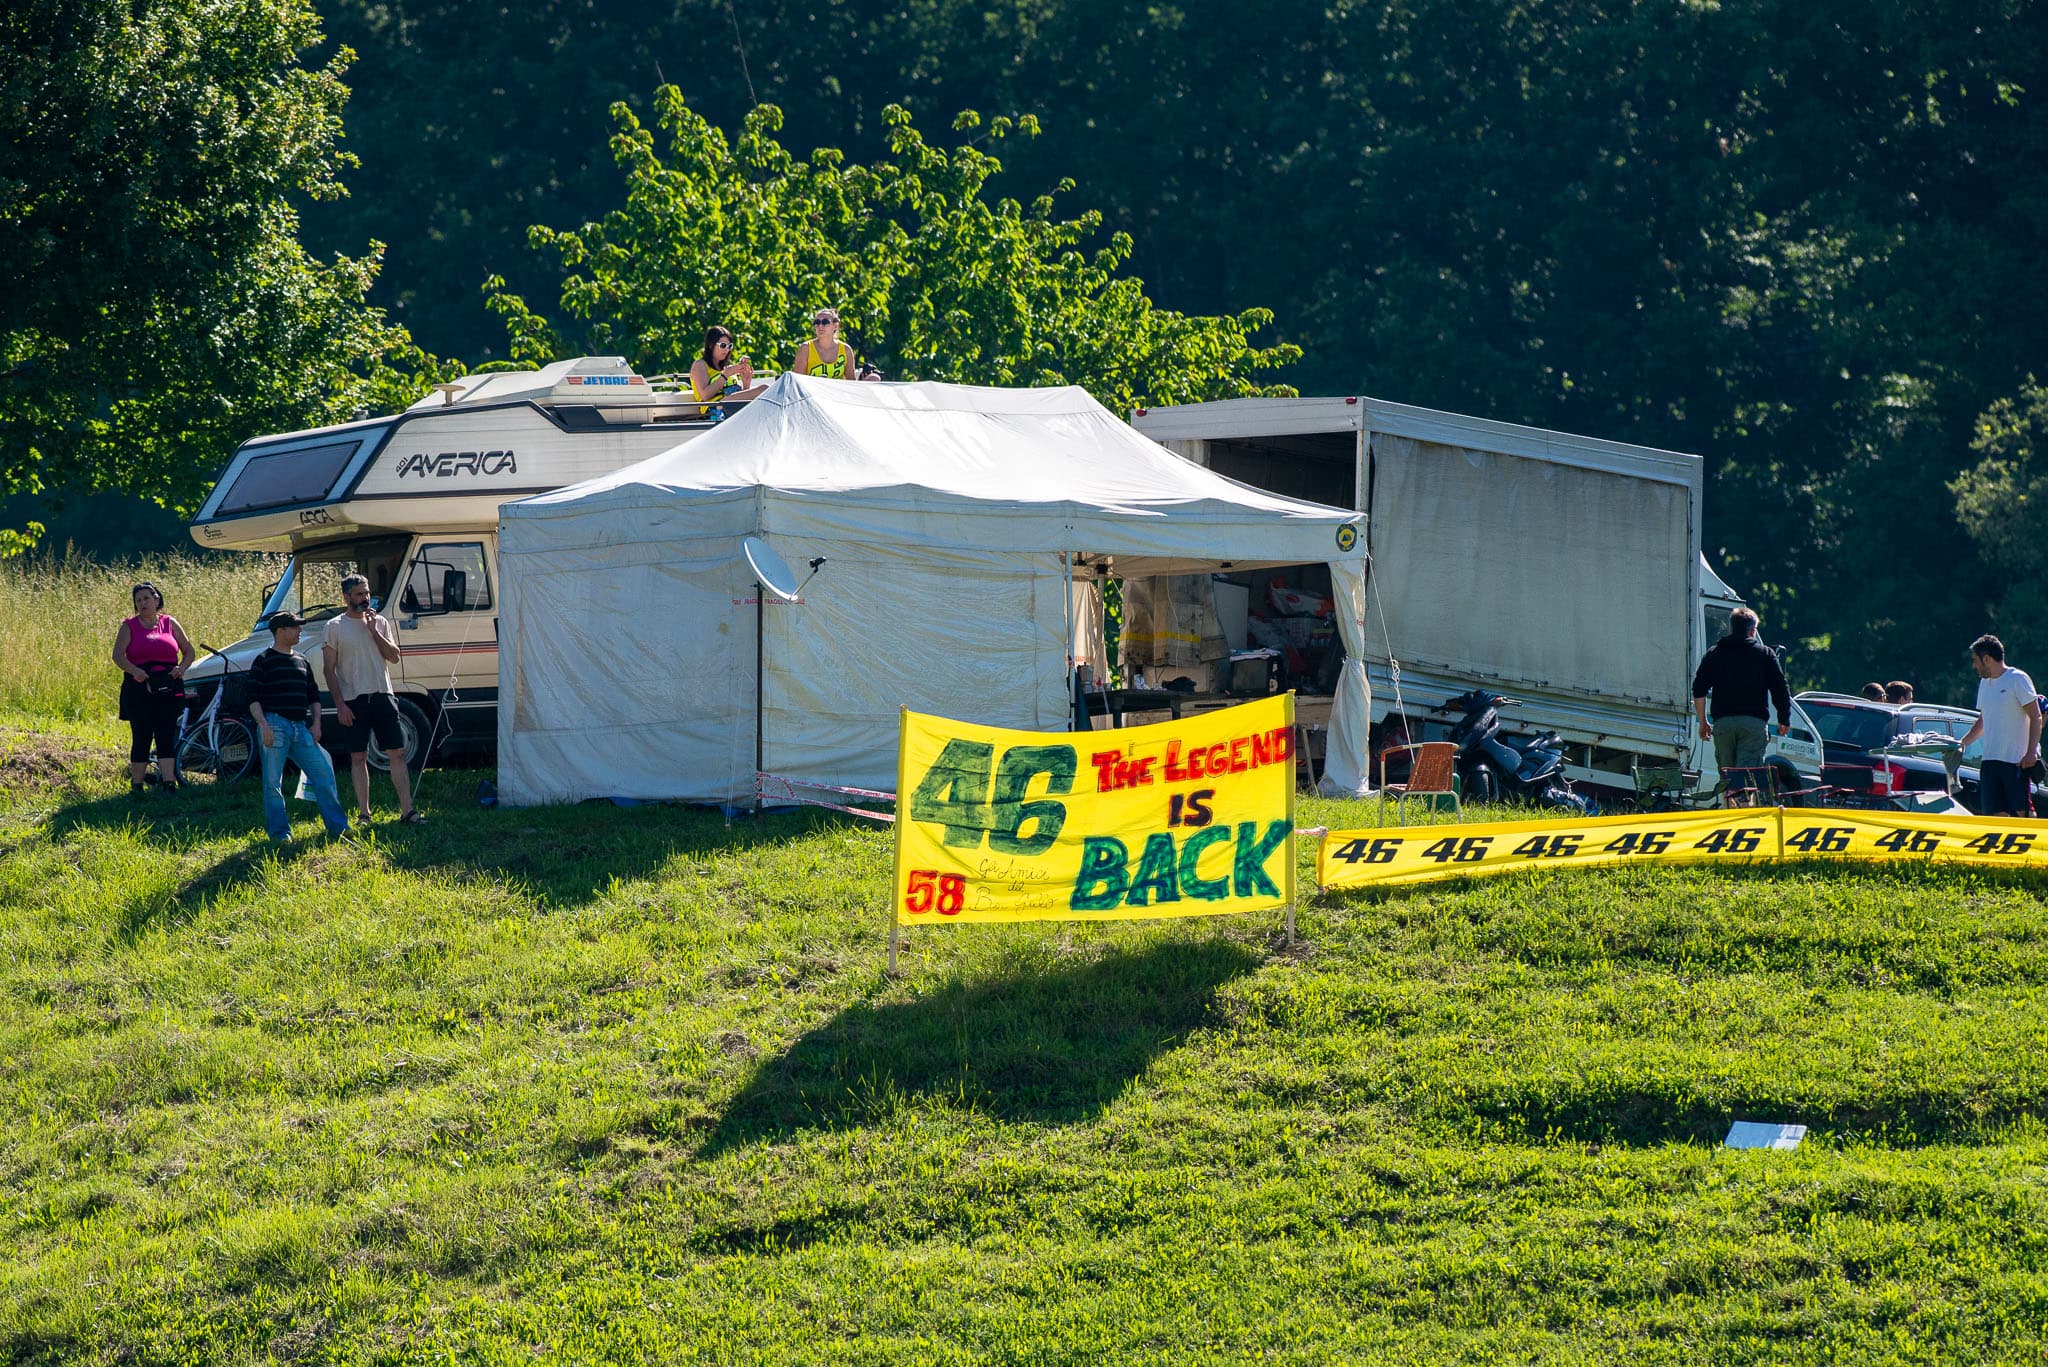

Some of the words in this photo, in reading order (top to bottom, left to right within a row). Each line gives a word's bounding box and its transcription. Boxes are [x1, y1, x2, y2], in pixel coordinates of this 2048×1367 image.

[583, 376, 629, 386] JETBAG
[399, 450, 517, 478] AMERICA
[300, 508, 335, 526] ARCA
[911, 738, 1078, 856] 46
[1168, 789, 1216, 828] IS
[1332, 838, 1404, 864] 46
[1422, 837, 1494, 863] 46
[1512, 834, 1585, 859] 46
[1604, 831, 1676, 856] 46
[1694, 828, 1767, 854] 46
[1786, 827, 1856, 852] 46
[1875, 828, 1947, 853] 46
[1965, 832, 2037, 855] 46
[1070, 819, 1294, 911] BACK
[905, 870, 966, 916] 58
